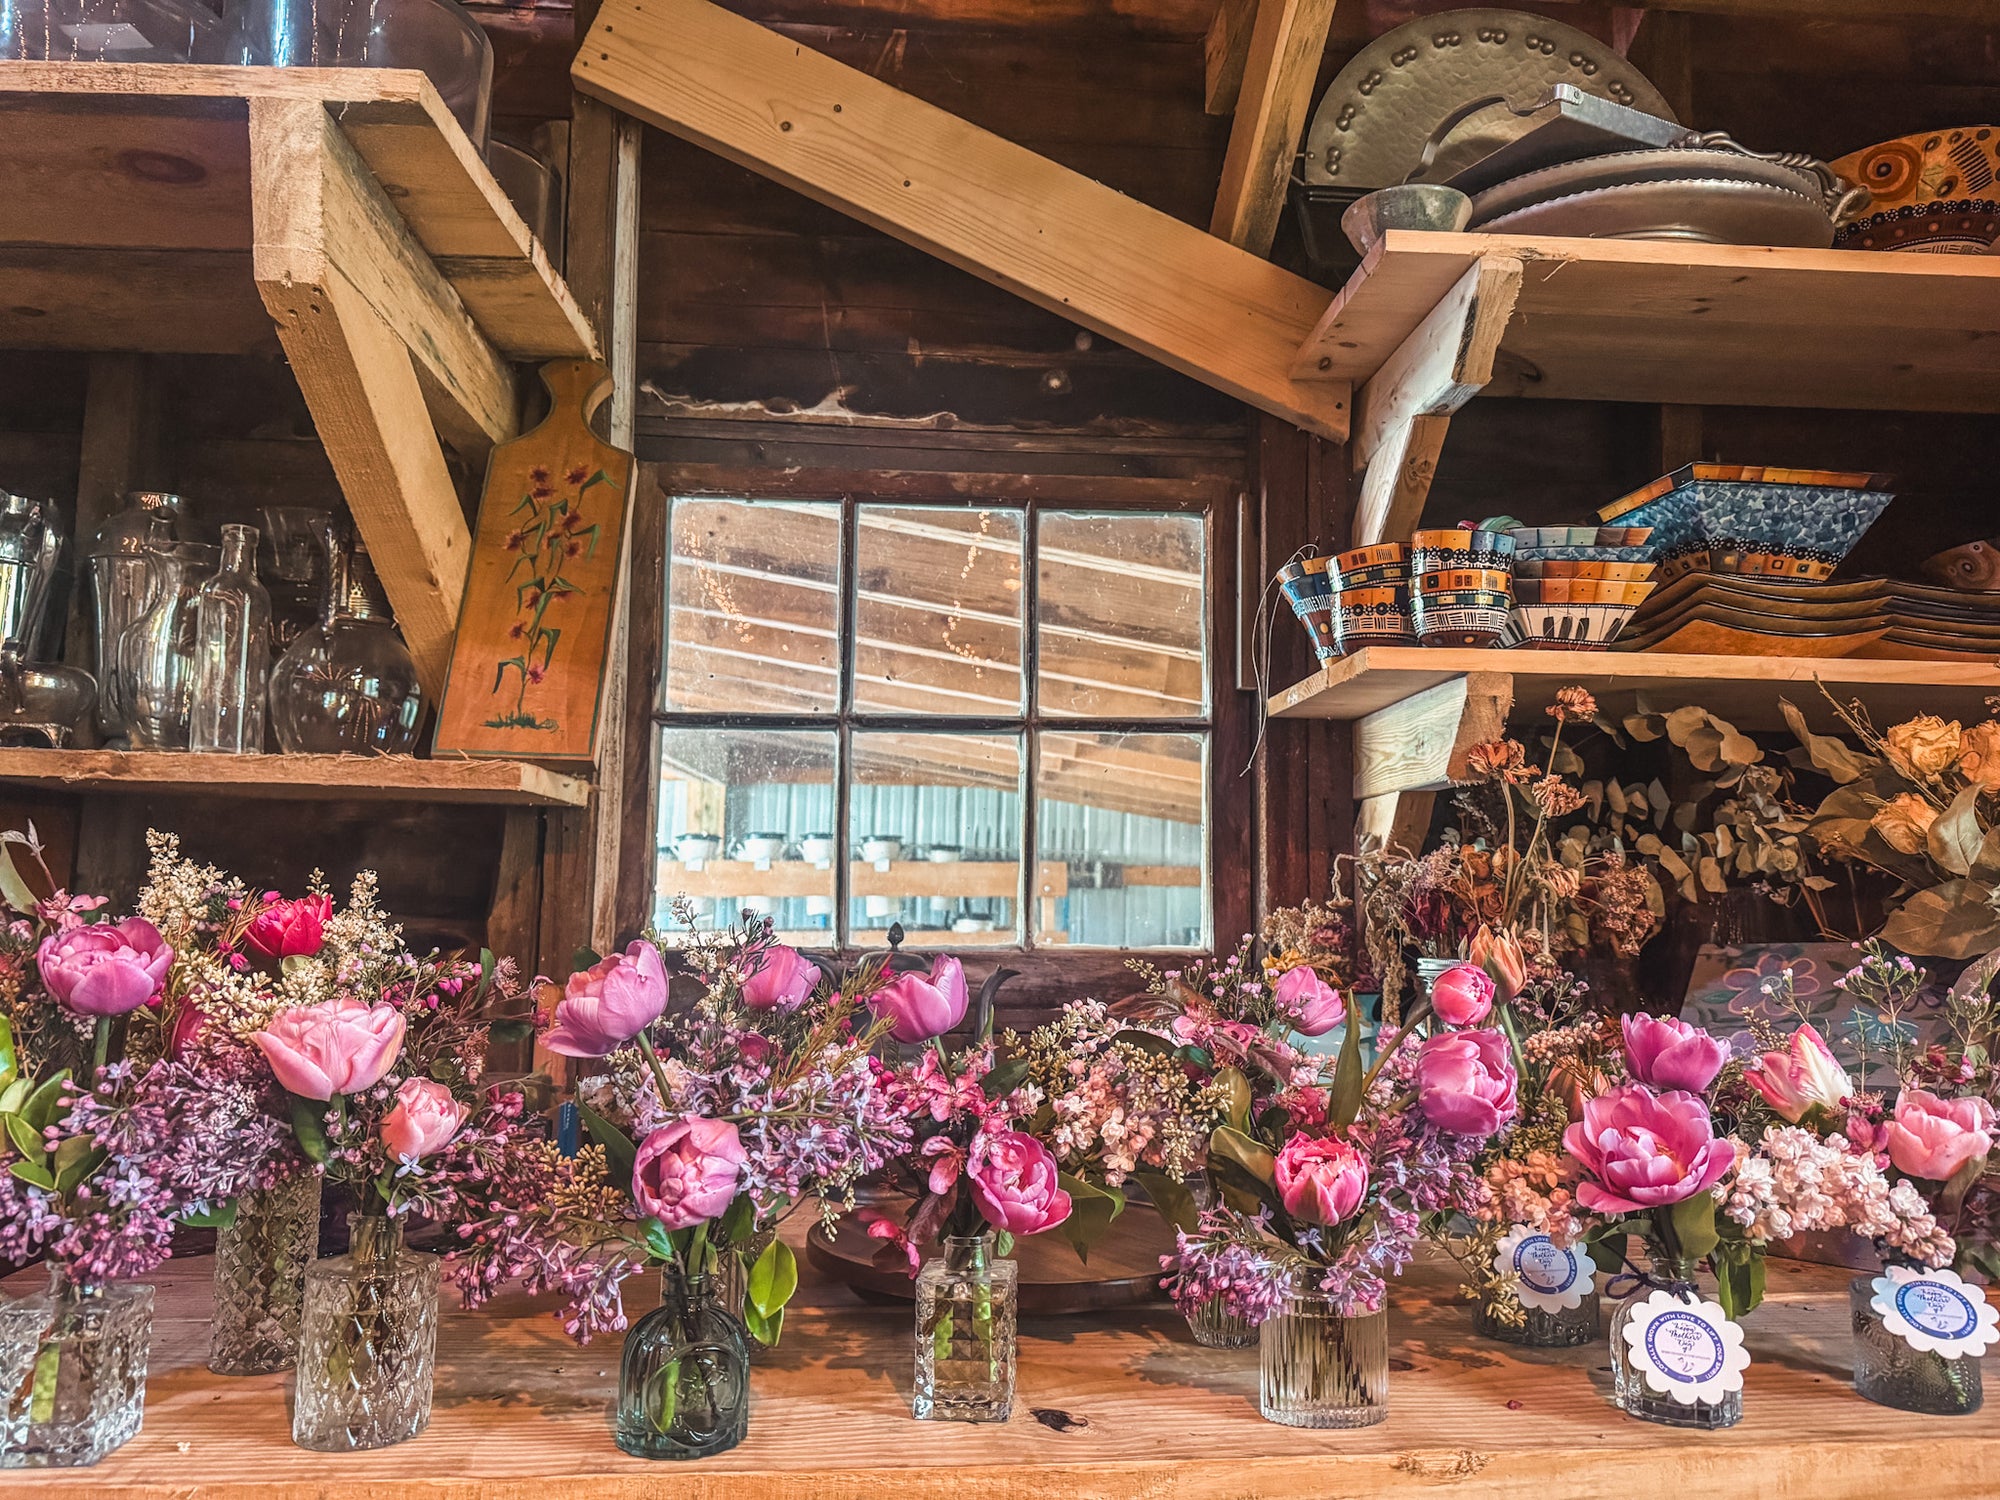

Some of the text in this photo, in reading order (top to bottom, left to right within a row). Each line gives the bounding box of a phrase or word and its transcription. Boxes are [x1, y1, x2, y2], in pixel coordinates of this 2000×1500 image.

[1659, 1313, 1676, 1322] WITH
[1676, 1313, 1696, 1322] LOVE
[1696, 1319, 1707, 1329] TO
[1647, 1320, 1660, 1342] GROWN
[1706, 1327, 1719, 1341] LIFT
[1647, 1343, 1669, 1373] LOCALLY
[1715, 1342, 1724, 1361] YOUR
